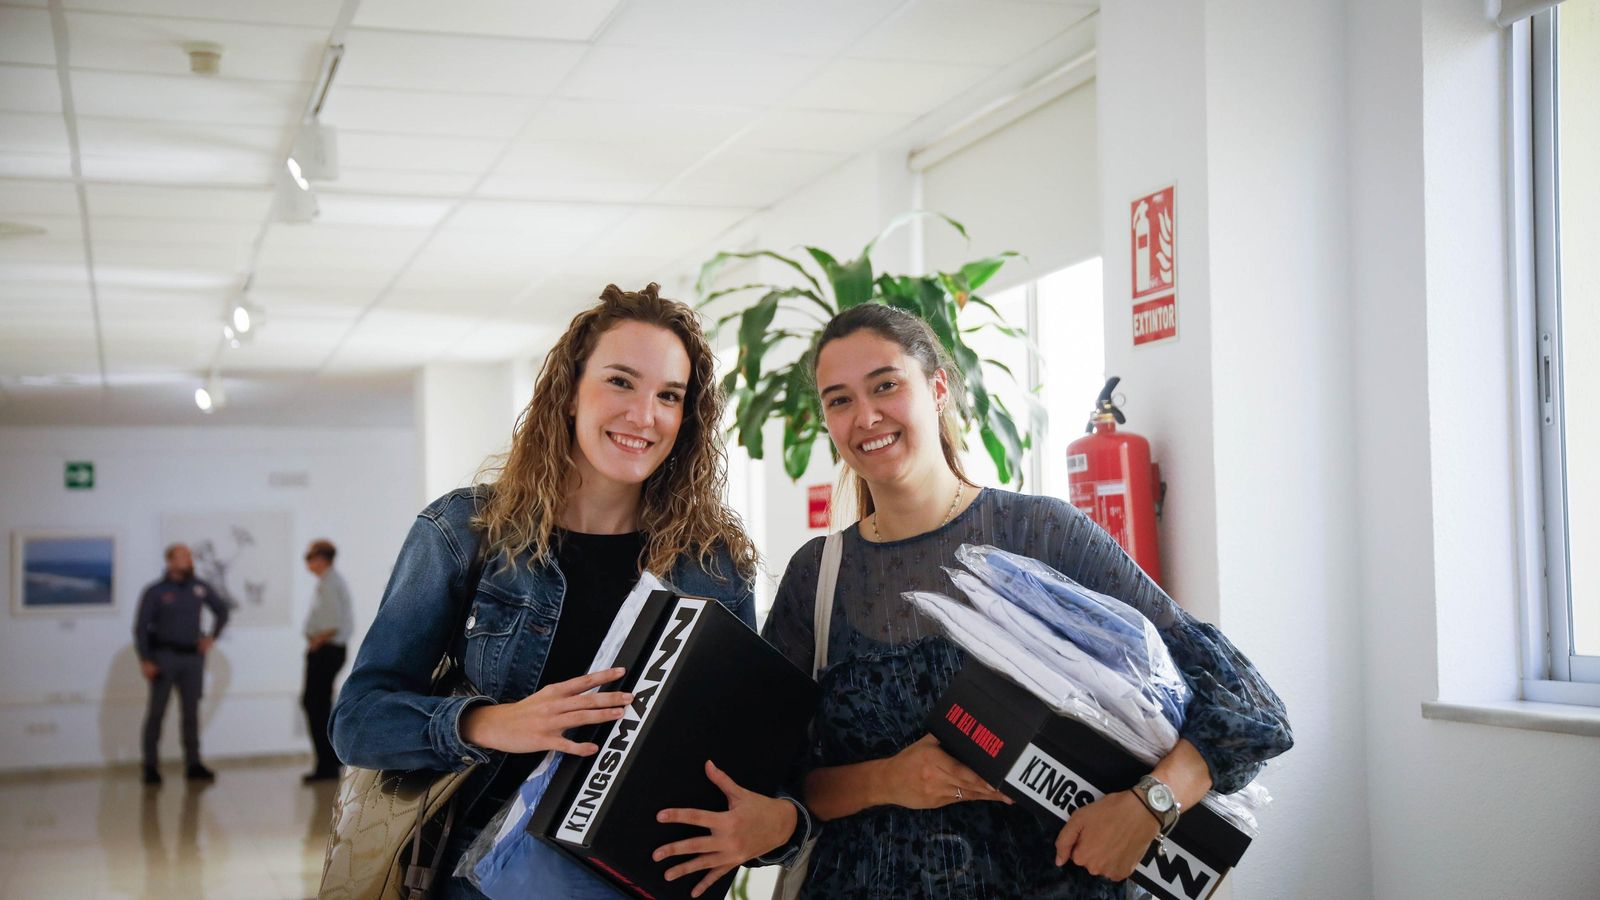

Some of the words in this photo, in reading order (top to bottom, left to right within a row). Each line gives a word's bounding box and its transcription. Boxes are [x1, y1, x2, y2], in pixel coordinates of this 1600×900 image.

[1133, 303, 1175, 337] EXTINTOR
[564, 606, 699, 833] KINGSMANN
[945, 703, 964, 725] FOR
[956, 712, 977, 736] REAL
[970, 722, 1004, 758] WORKERS
[1018, 755, 1211, 900] KINGSNN
